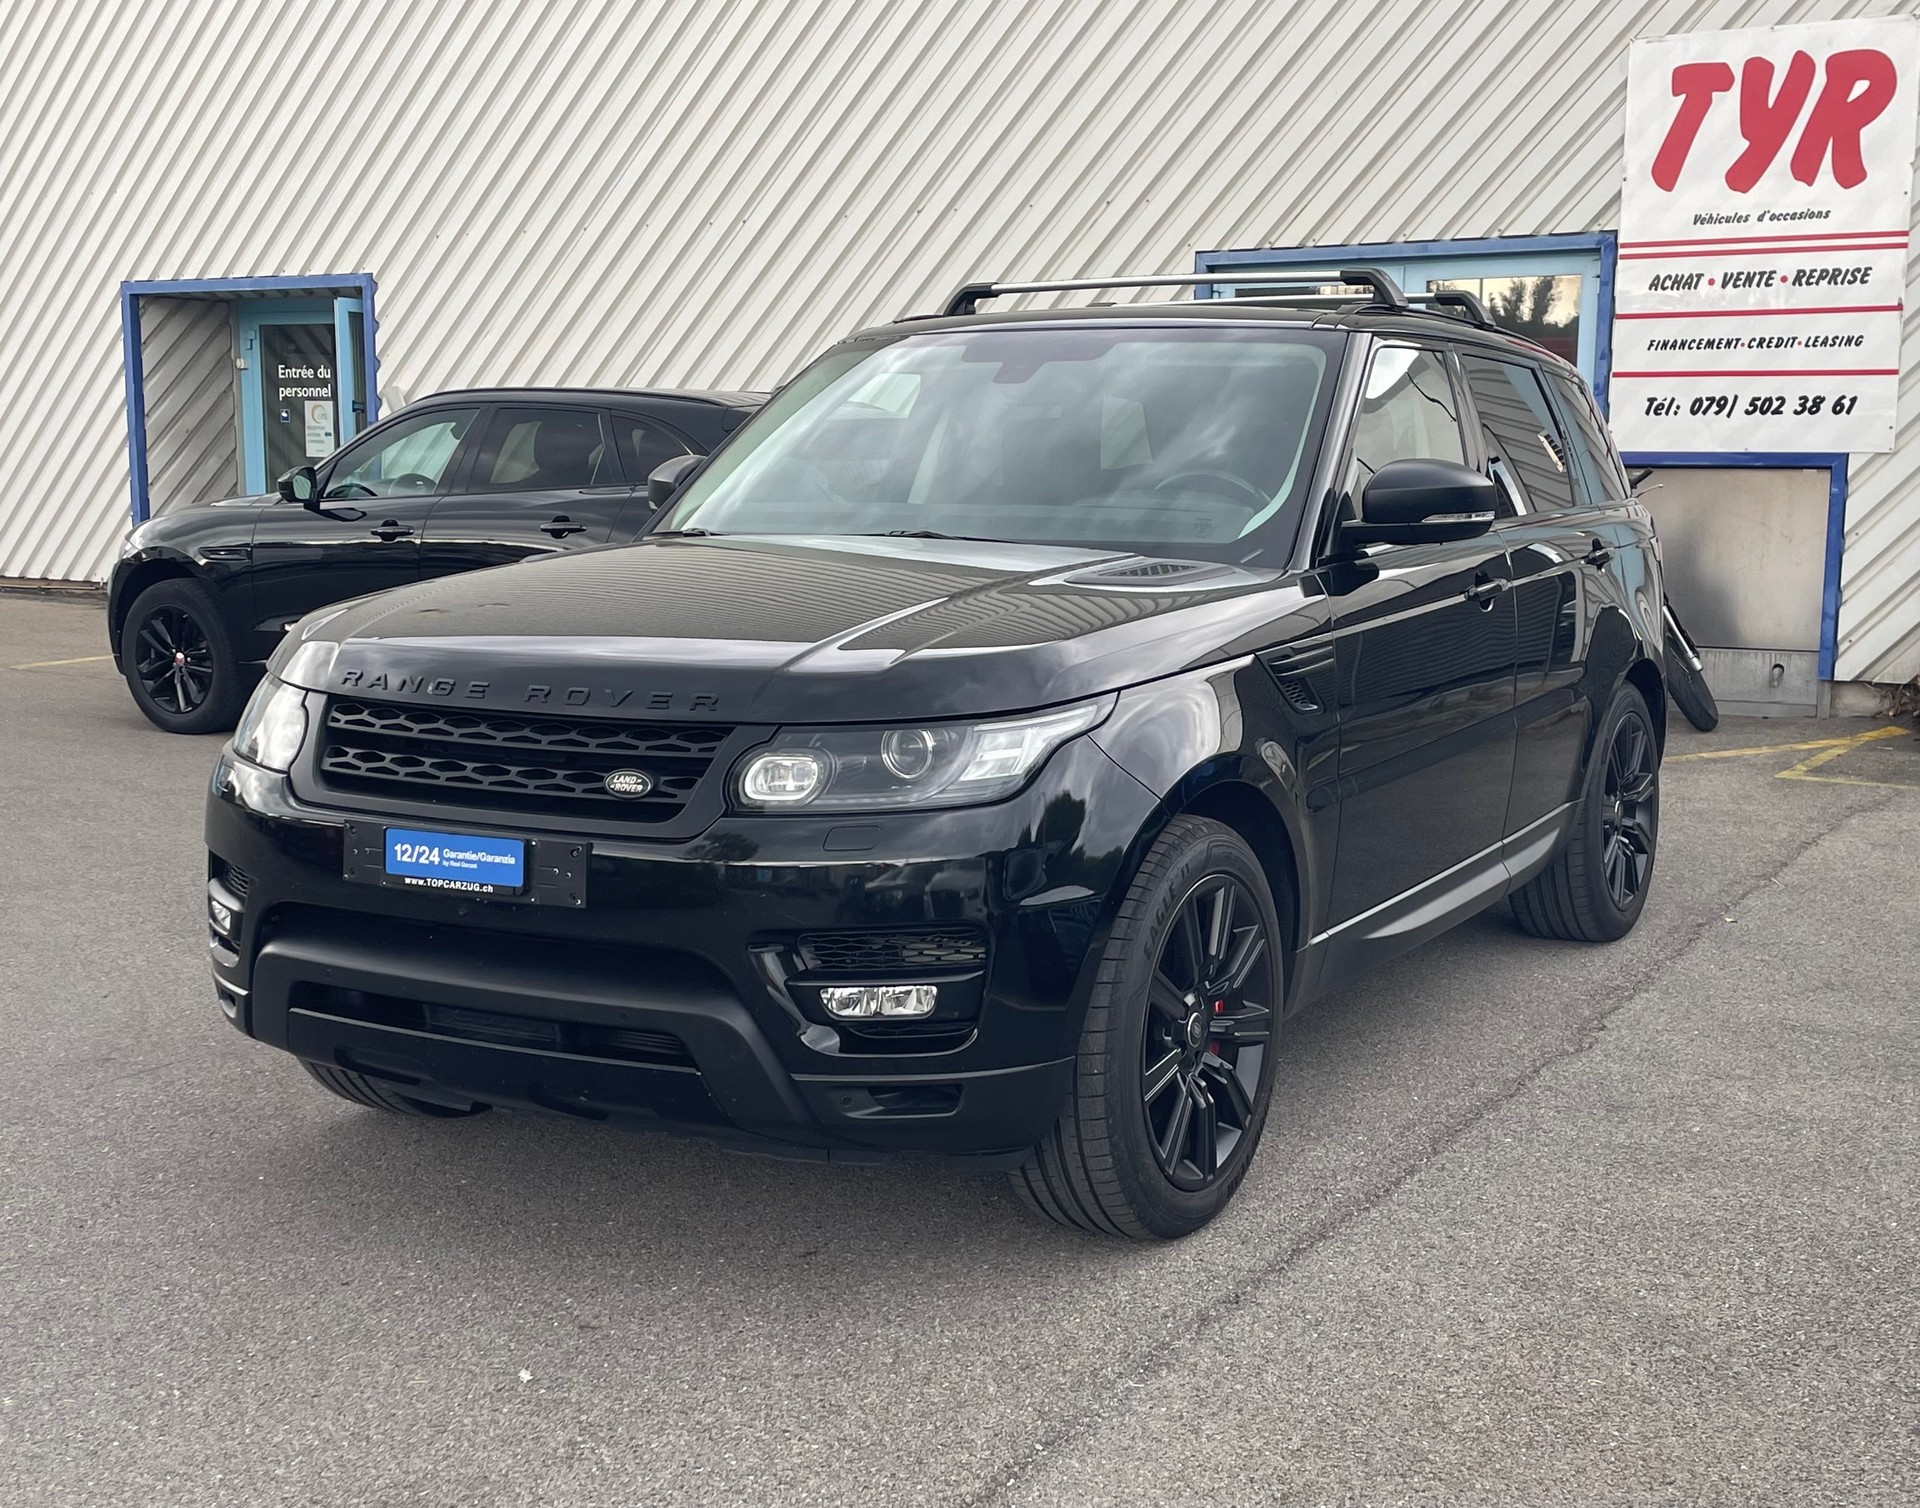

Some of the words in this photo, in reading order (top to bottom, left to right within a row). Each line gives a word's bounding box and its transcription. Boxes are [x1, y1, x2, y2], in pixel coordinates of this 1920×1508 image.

[1652, 49, 1897, 193] TYR
[1693, 212, 1751, 226] Véhicules
[1757, 208, 1831, 222] d'occasions
[1648, 272, 1704, 292] ACHAT
[1721, 270, 1777, 290] VENTE
[1792, 266, 1873, 288] REPRISE
[278, 364, 315, 379] Entrée
[317, 364, 331, 379] du
[279, 383, 331, 401] personnel
[1644, 396, 1681, 416] Tél:
[1744, 396, 1786, 416] 502
[1793, 395, 1826, 416] 38
[1831, 394, 1858, 416] 61
[340, 668, 491, 699] RANGE
[523, 685, 721, 712] ROVER
[613, 775, 638, 784] LAND
[614, 783, 644, 793] ROVER
[394, 843, 441, 865] 12/24
[443, 848, 516, 865] Garantie/Garanzia
[404, 877, 493, 893] www.TOPCARZUG.ch
